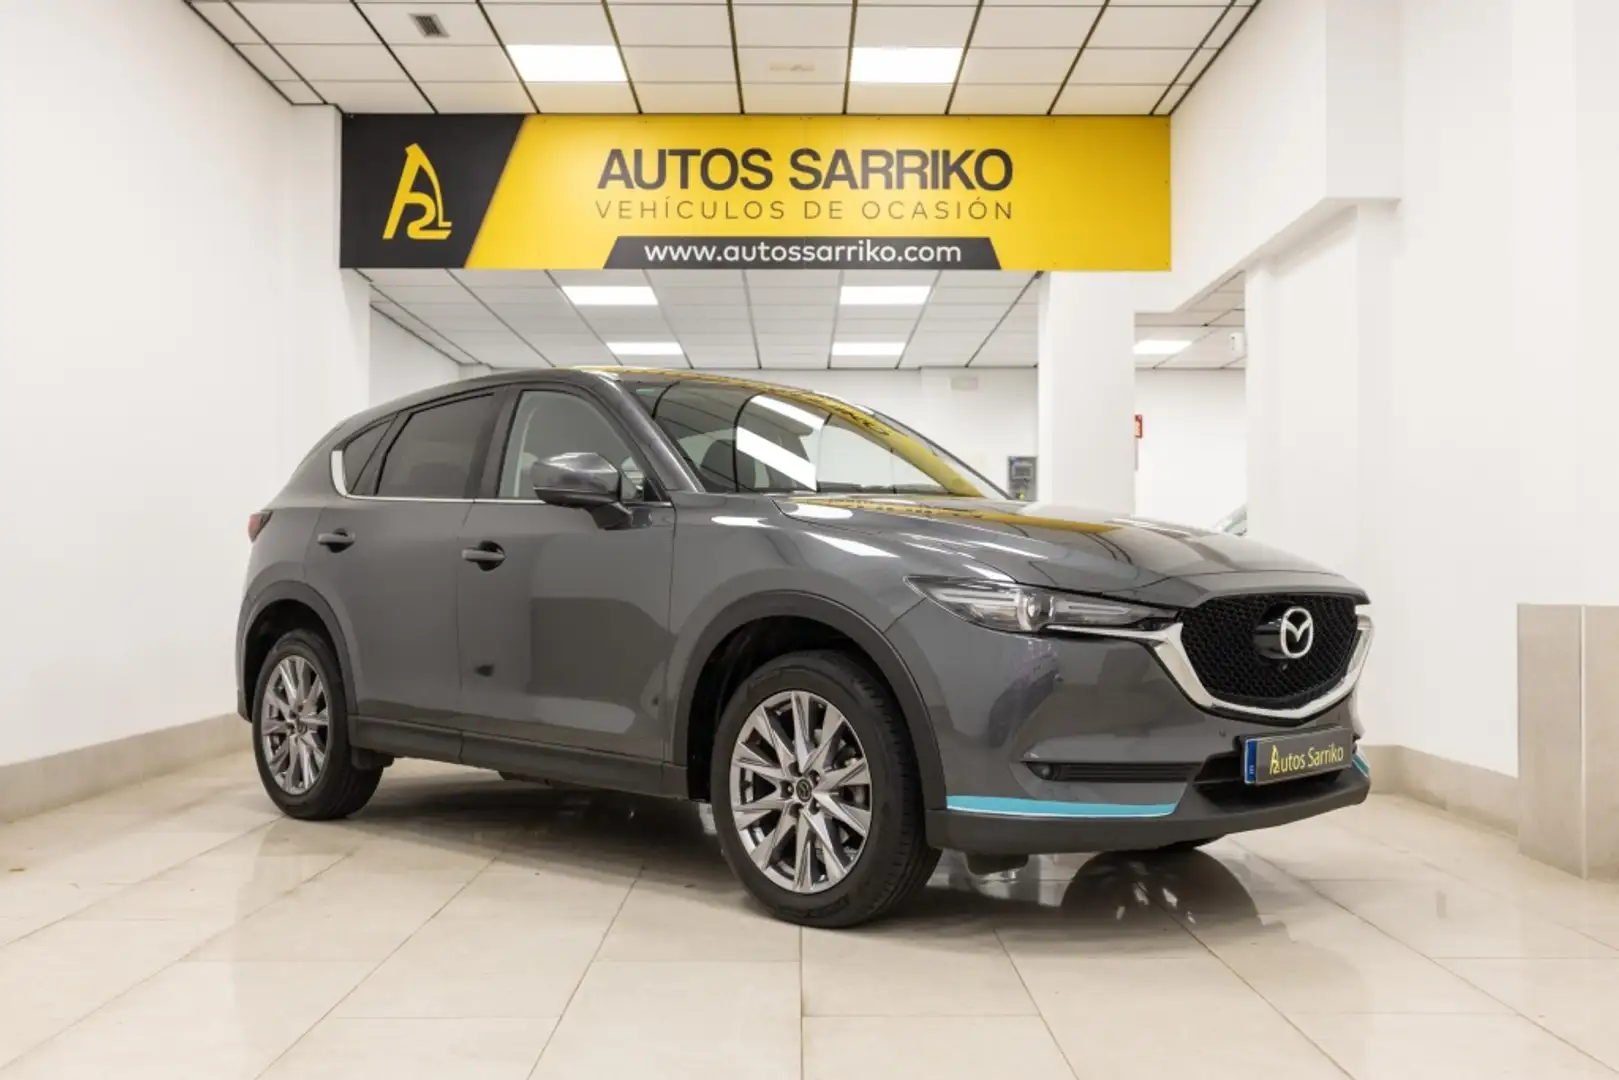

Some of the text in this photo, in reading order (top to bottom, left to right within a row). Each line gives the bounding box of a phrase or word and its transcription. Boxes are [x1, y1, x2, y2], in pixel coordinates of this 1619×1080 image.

[597, 148, 1013, 191] AUTOS SARRIKO
[595, 196, 1012, 220] VEHÍCULOS DE OCASIÓN
[644, 239, 962, 262] www.autossarriko.com
[1269, 745, 1306, 775] Autos
[1307, 743, 1344, 767] Sarriko
